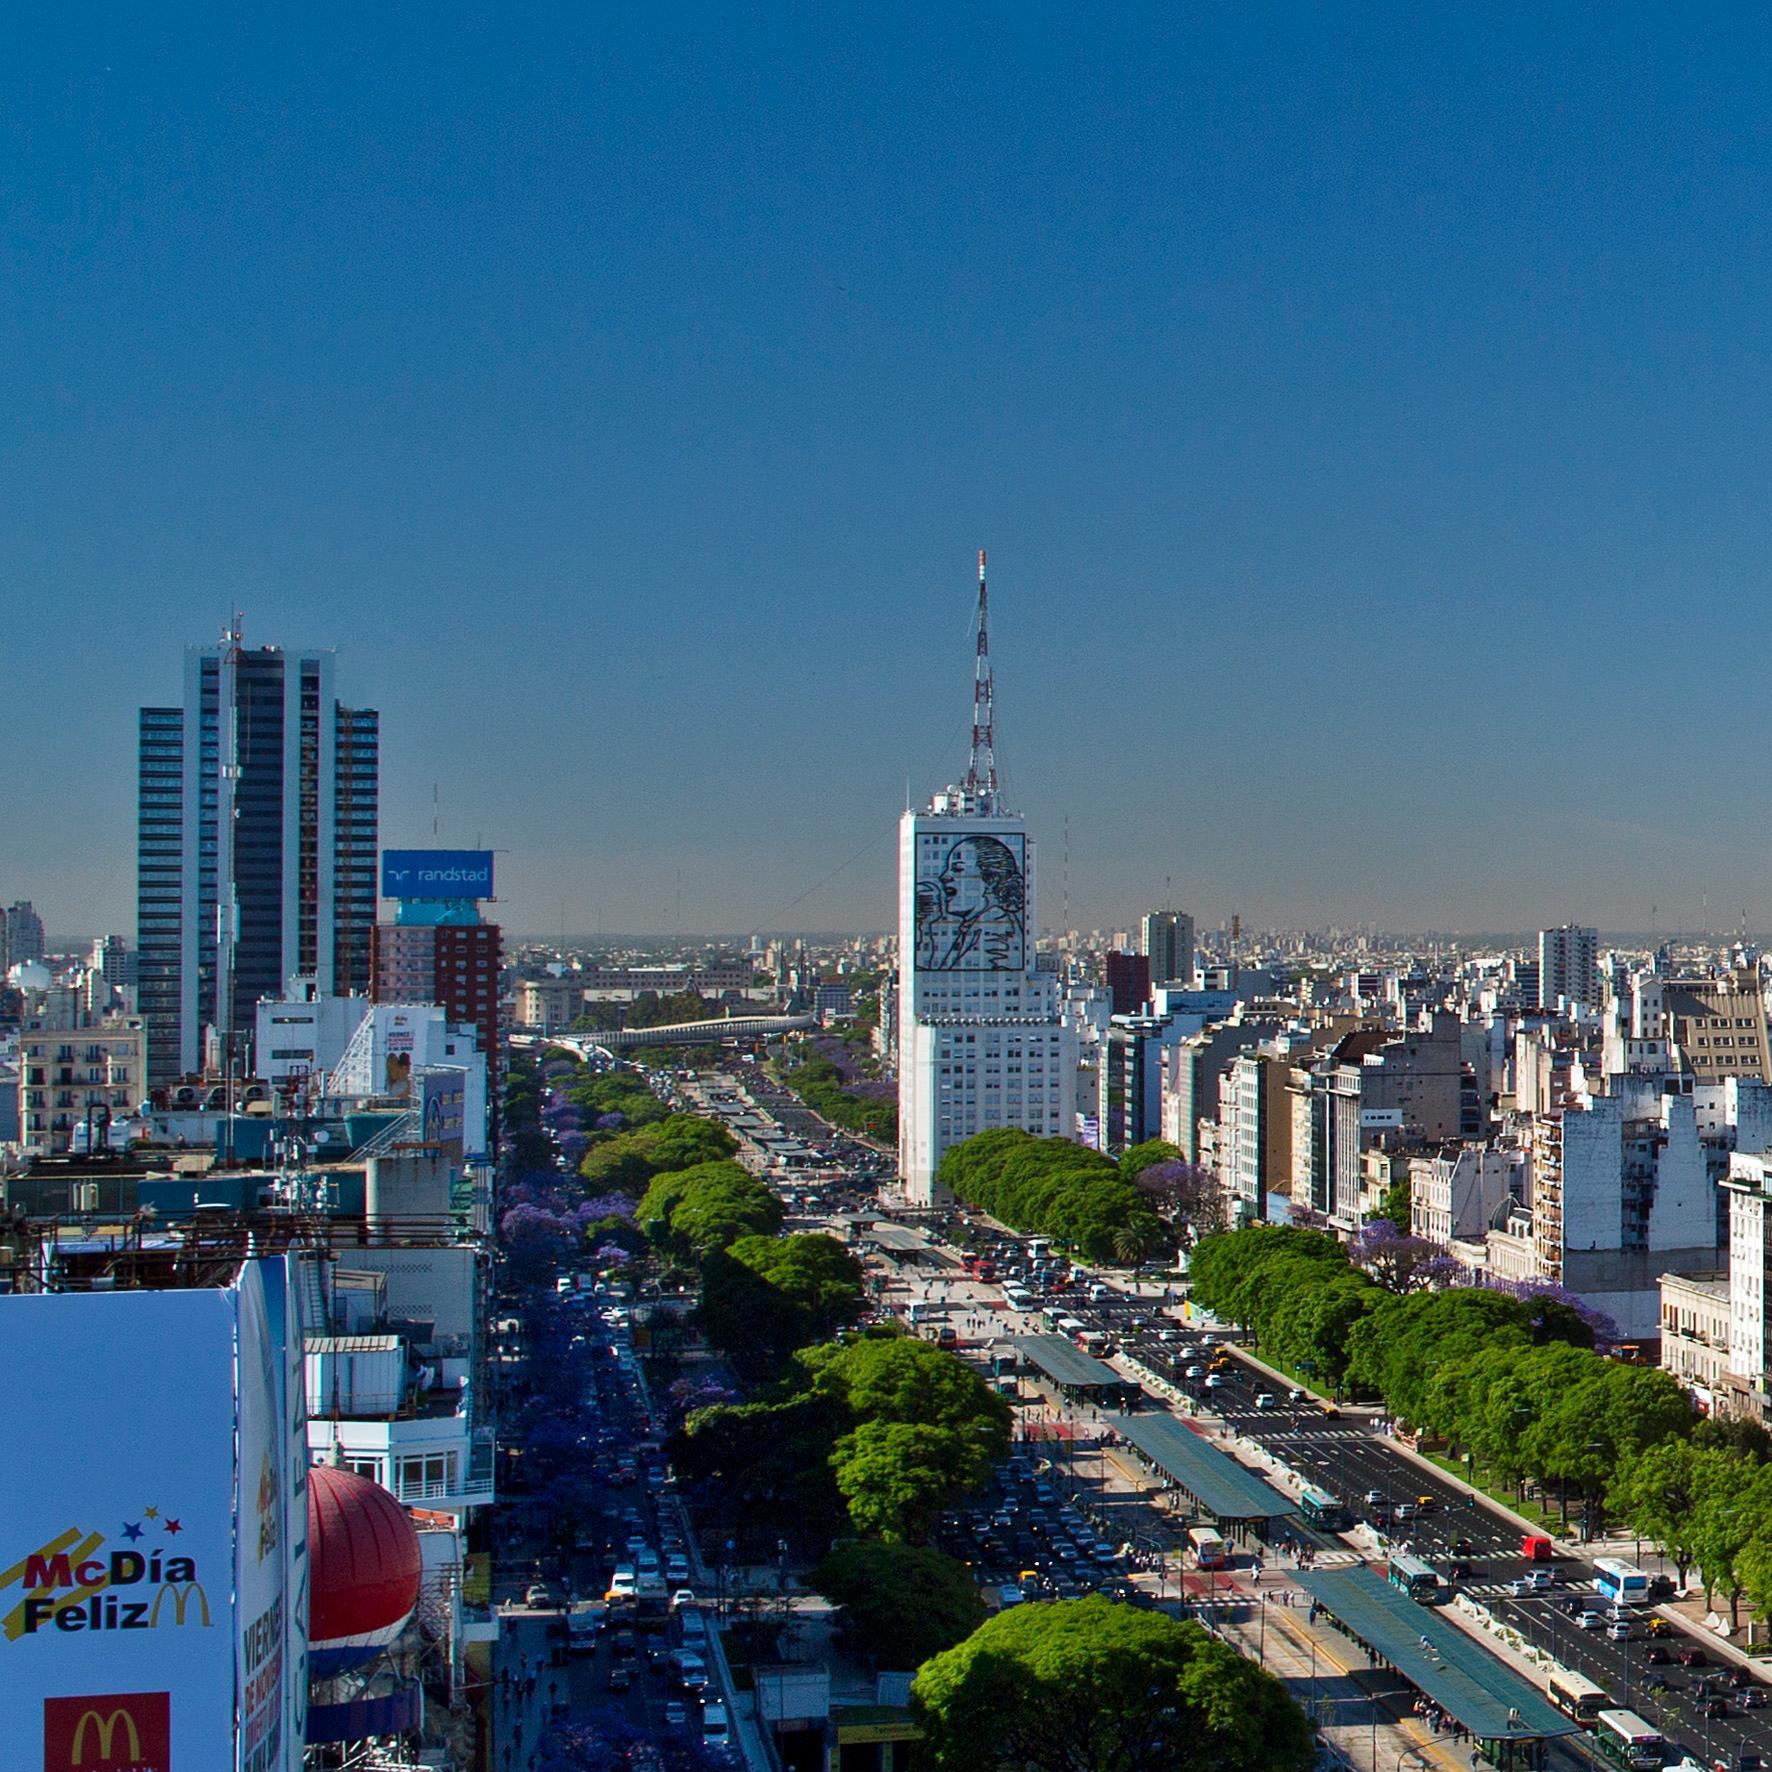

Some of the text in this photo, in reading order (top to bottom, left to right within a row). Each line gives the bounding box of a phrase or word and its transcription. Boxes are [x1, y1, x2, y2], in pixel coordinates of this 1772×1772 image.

[418, 867, 488, 881] randstad
[22, 1549, 196, 1589] McDía
[24, 1595, 149, 1634] Feliz
